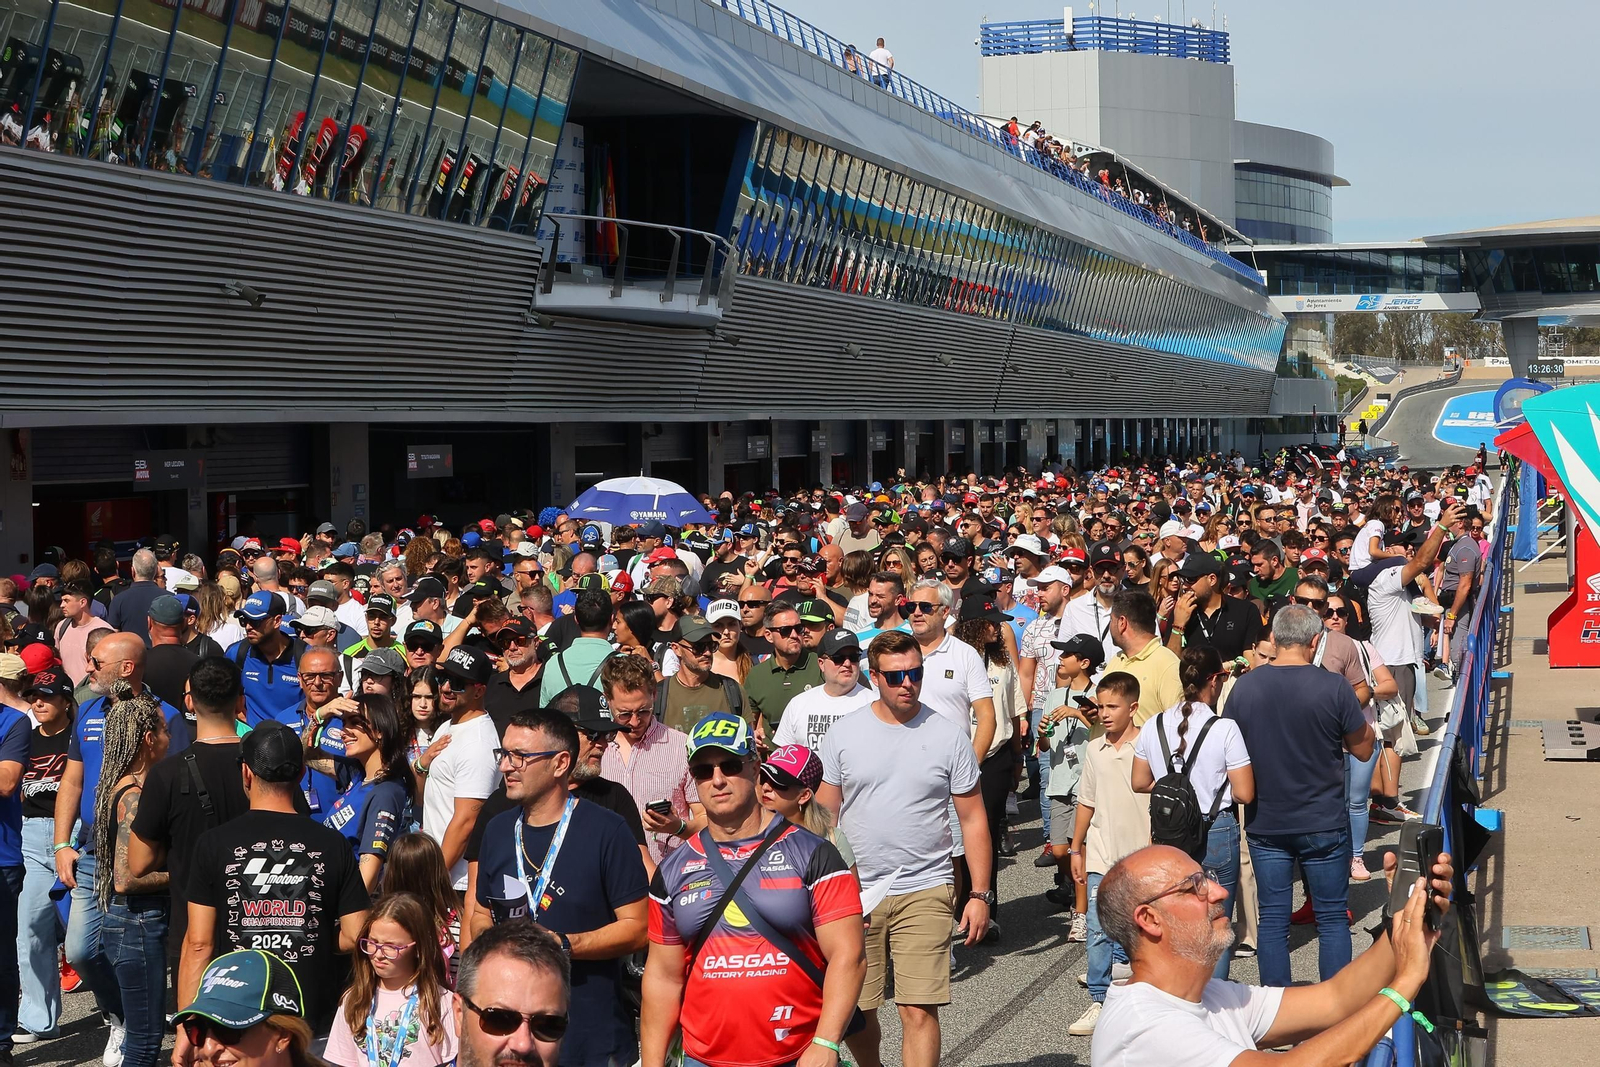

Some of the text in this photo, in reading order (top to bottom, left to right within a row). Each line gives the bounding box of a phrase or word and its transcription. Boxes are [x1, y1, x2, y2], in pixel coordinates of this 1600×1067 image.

[1528, 364, 1564, 374] 13:26:30
[725, 603, 738, 611] 93
[808, 714, 819, 722] NO
[820, 715, 831, 723] ME
[693, 719, 740, 739] 46
[680, 892, 698, 906] elf
[242, 900, 306, 916] WORLD
[241, 918, 305, 927] CHAMPIONSHIP
[252, 934, 292, 949] 2024
[703, 953, 790, 970] GASGAS
[746, 968, 787, 977] RACING
